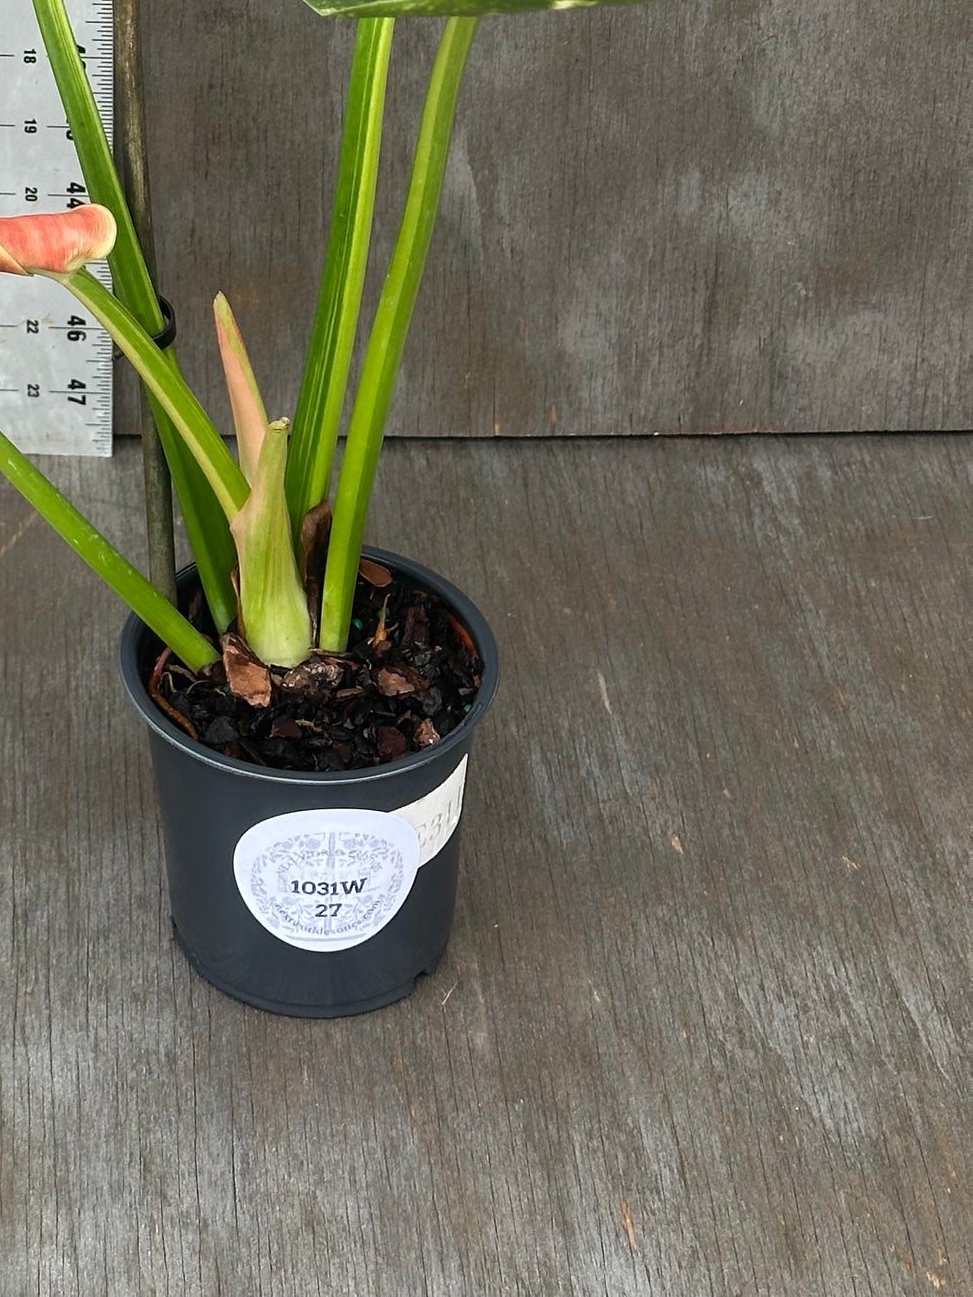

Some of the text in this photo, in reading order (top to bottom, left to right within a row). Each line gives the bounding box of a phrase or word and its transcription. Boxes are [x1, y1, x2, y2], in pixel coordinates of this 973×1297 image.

[23, 48, 37, 64] 18
[24, 118, 37, 134] 19
[25, 187, 38, 202] 20
[26, 319, 39, 334] 22
[67, 314, 87, 342] 46
[27, 383, 39, 398] 23
[67, 378, 87, 406] 47
[290, 877, 368, 896] 1031W
[314, 903, 343, 918] 27
